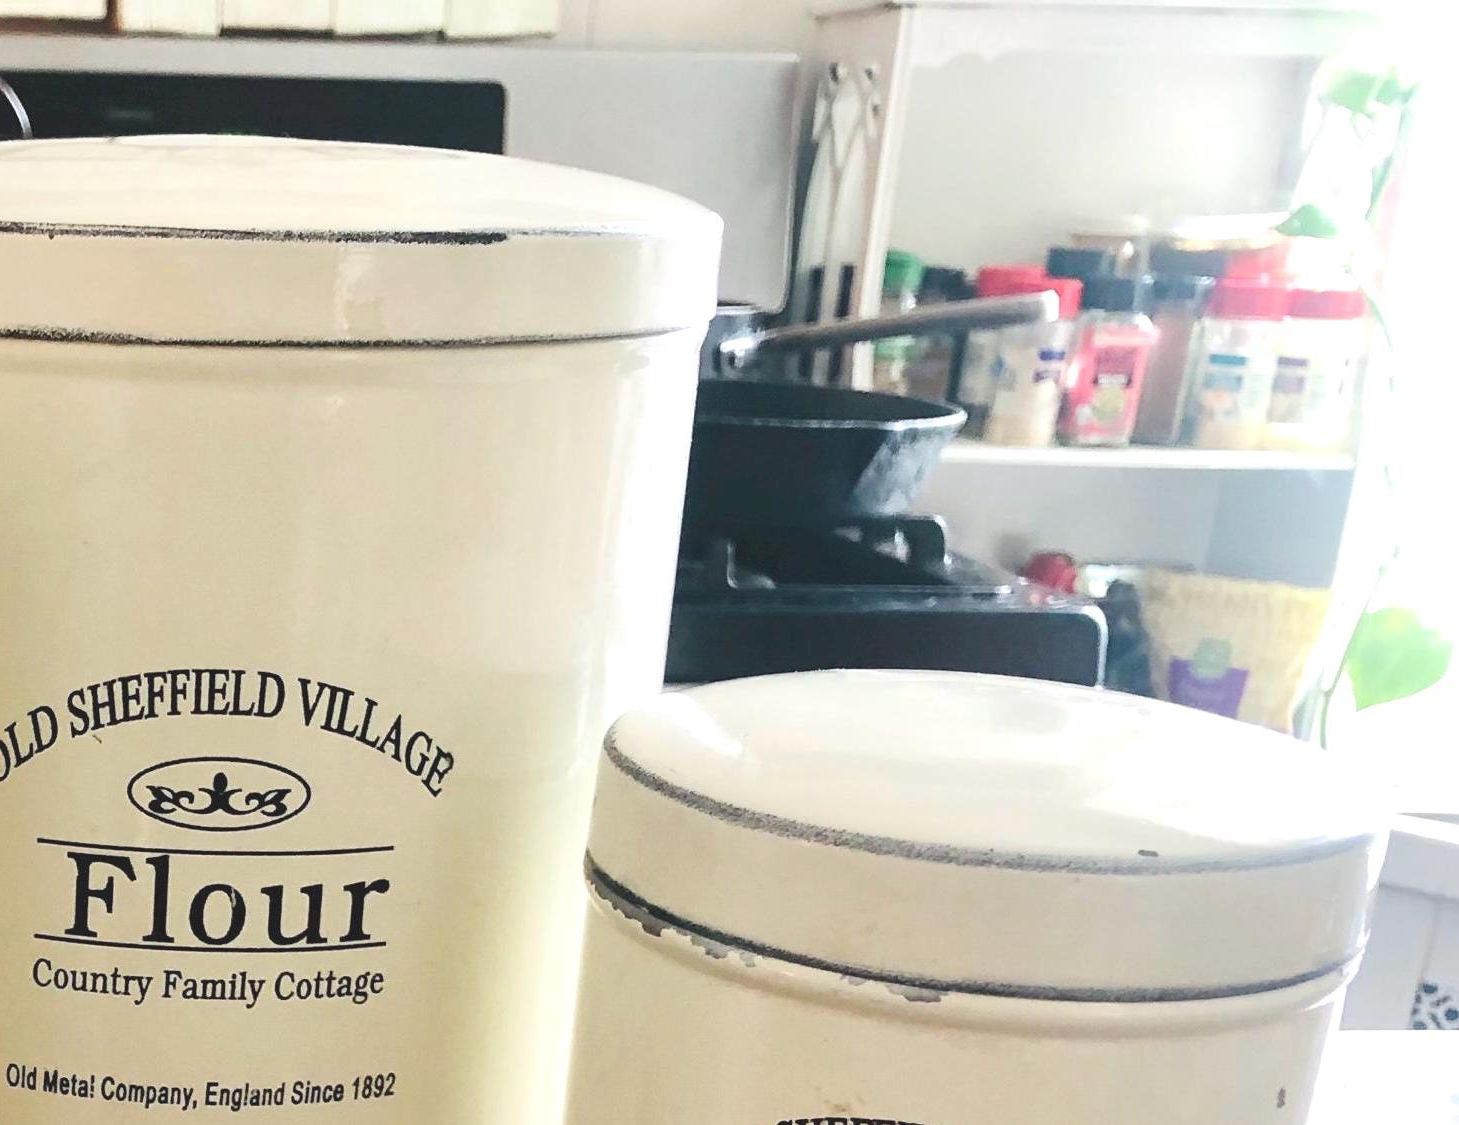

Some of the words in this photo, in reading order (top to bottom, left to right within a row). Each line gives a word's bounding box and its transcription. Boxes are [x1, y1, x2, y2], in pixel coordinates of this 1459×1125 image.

[66, 668, 286, 739] SHEFFIELD
[297, 677, 455, 798] VILLAGE
[64, 851, 390, 946] Flour
[32, 957, 154, 1006] Country
[161, 969, 266, 1010] Family
[274, 970, 385, 1005] Cottage
[6, 1063, 38, 1091] Old
[42, 1069, 96, 1099] Metal
[100, 1075, 198, 1112] Company,
[204, 1080, 286, 1113] England
[290, 1080, 345, 1106] Since
[352, 1072, 396, 1101] 1892
